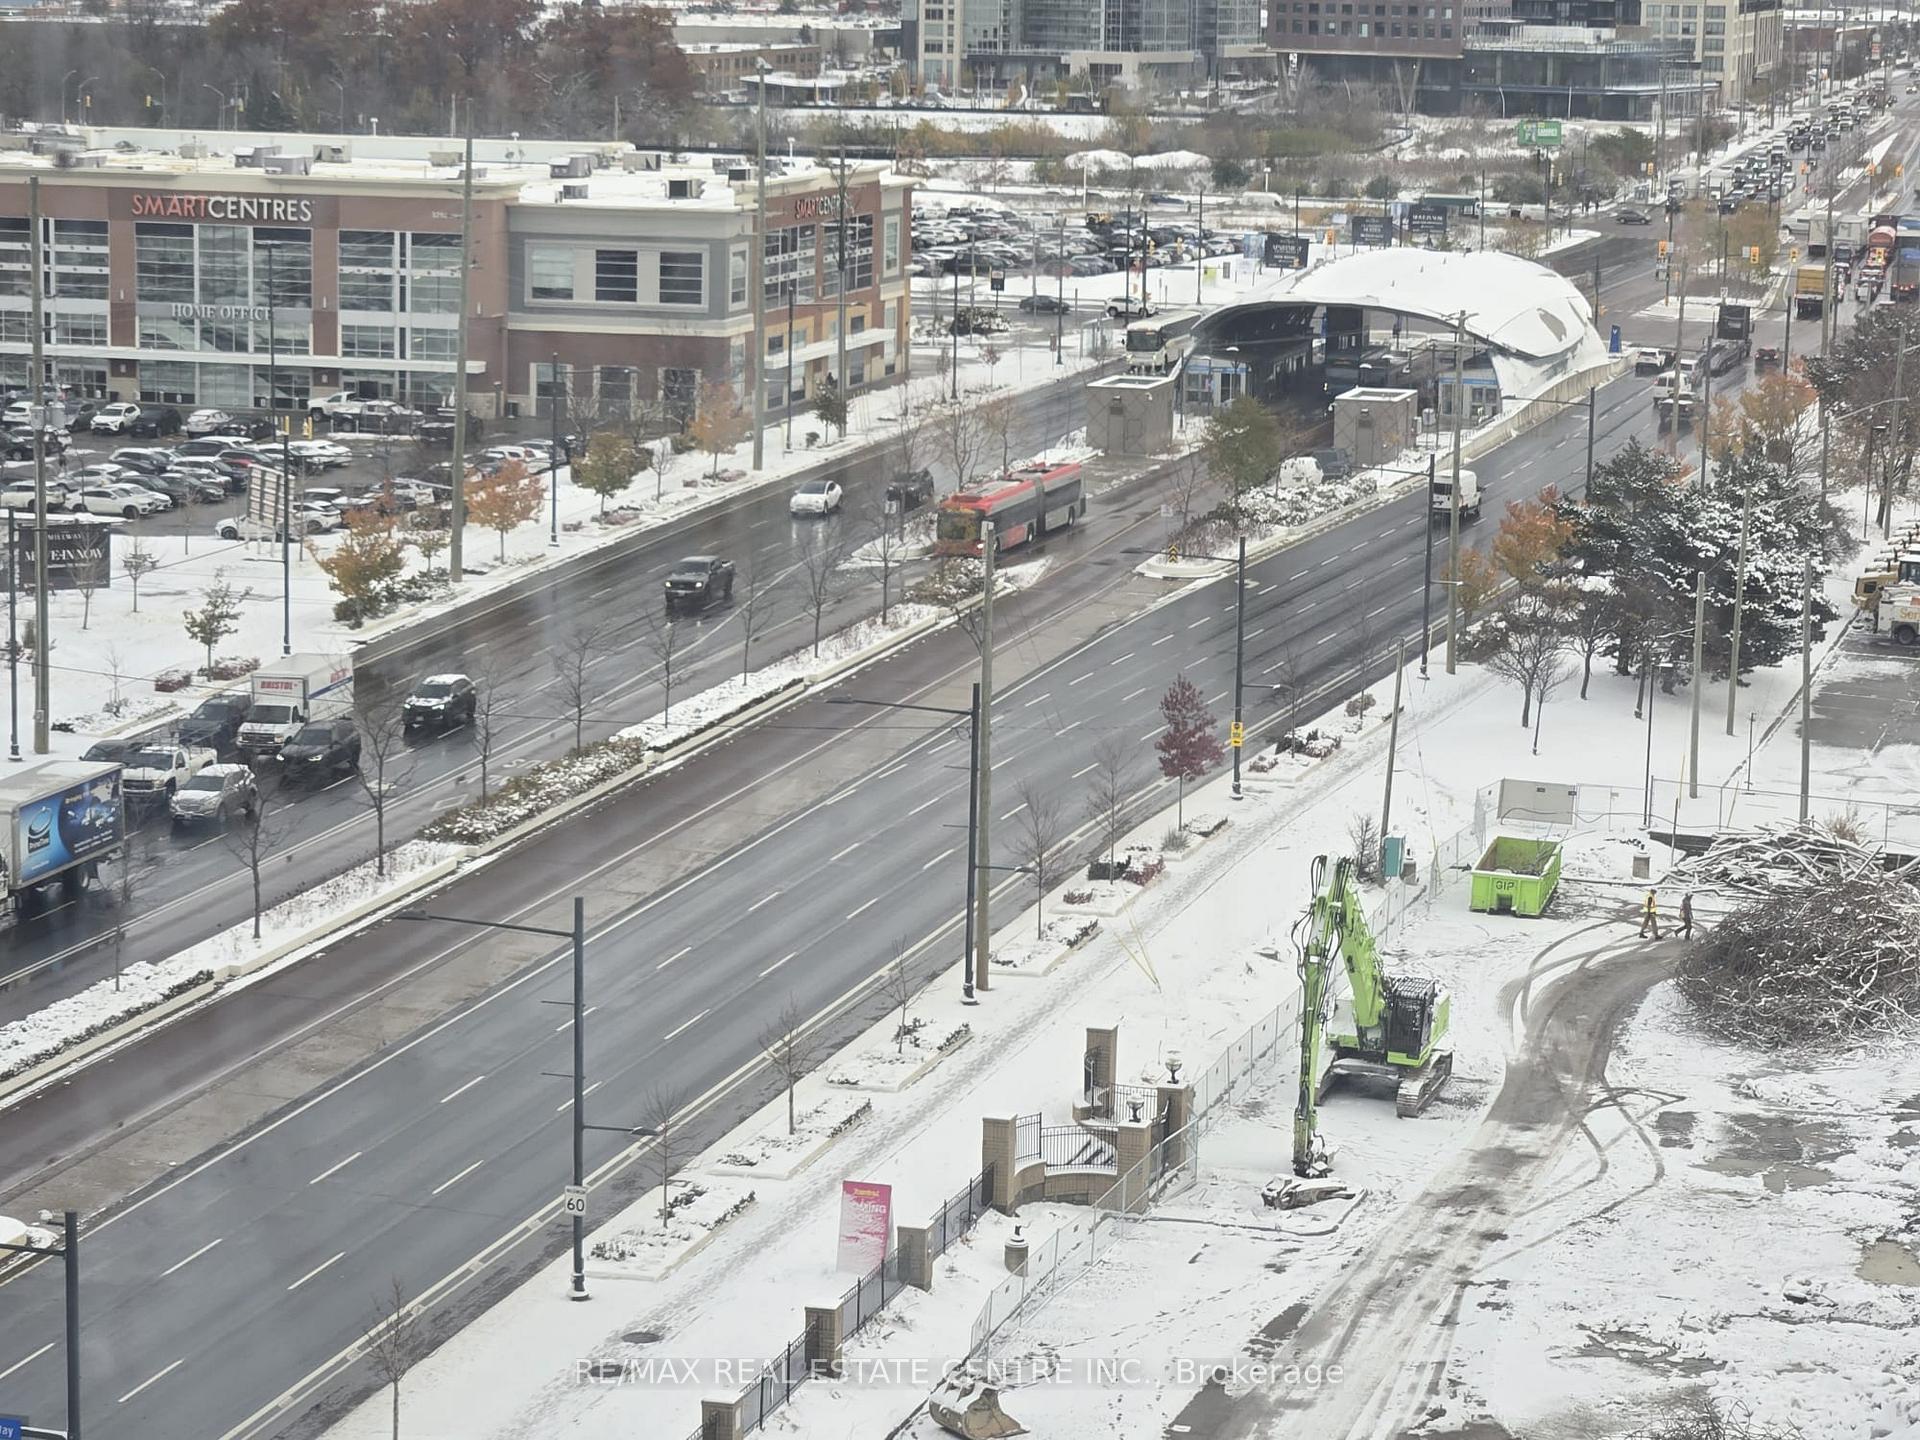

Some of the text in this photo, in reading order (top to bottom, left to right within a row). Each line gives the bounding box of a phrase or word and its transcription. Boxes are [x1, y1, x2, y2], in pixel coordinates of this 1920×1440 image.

[132, 194, 313, 222] SMARTCENTRES
[171, 302, 216, 319] HOME
[1495, 880, 1515, 891] GIP
[566, 1198, 585, 1212] 60
